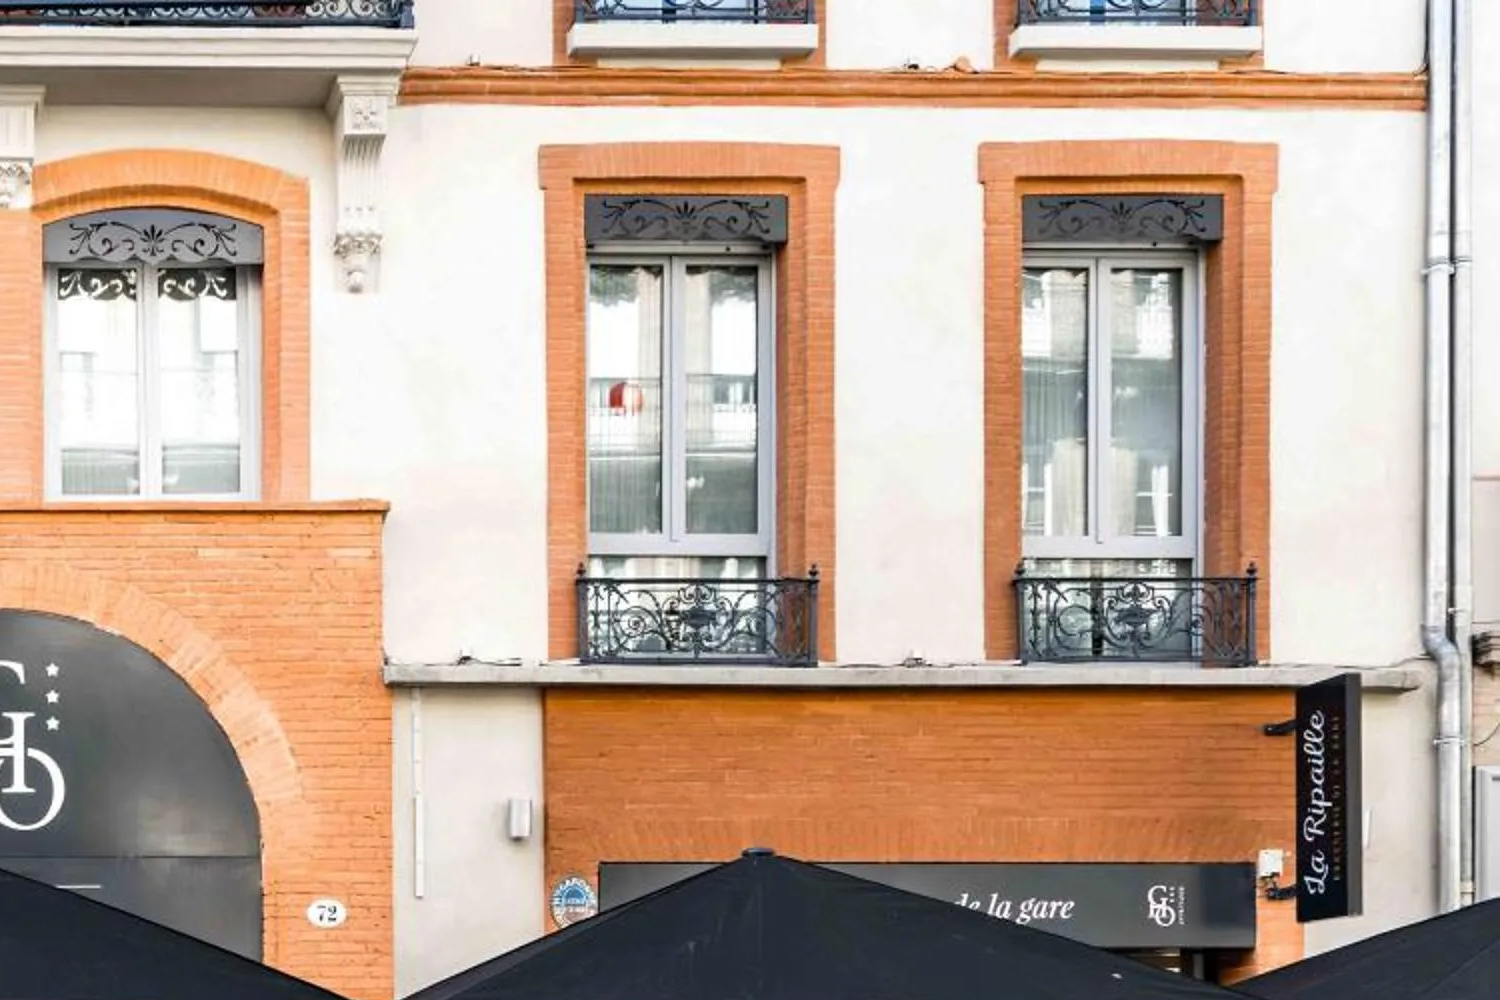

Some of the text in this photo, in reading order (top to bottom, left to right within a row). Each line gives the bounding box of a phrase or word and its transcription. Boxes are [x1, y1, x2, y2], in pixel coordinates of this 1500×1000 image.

[1304, 709, 1333, 895] La Ripaille
[315, 904, 337, 922] 72
[987, 892, 1012, 918] la
[1015, 897, 1075, 925] gare
